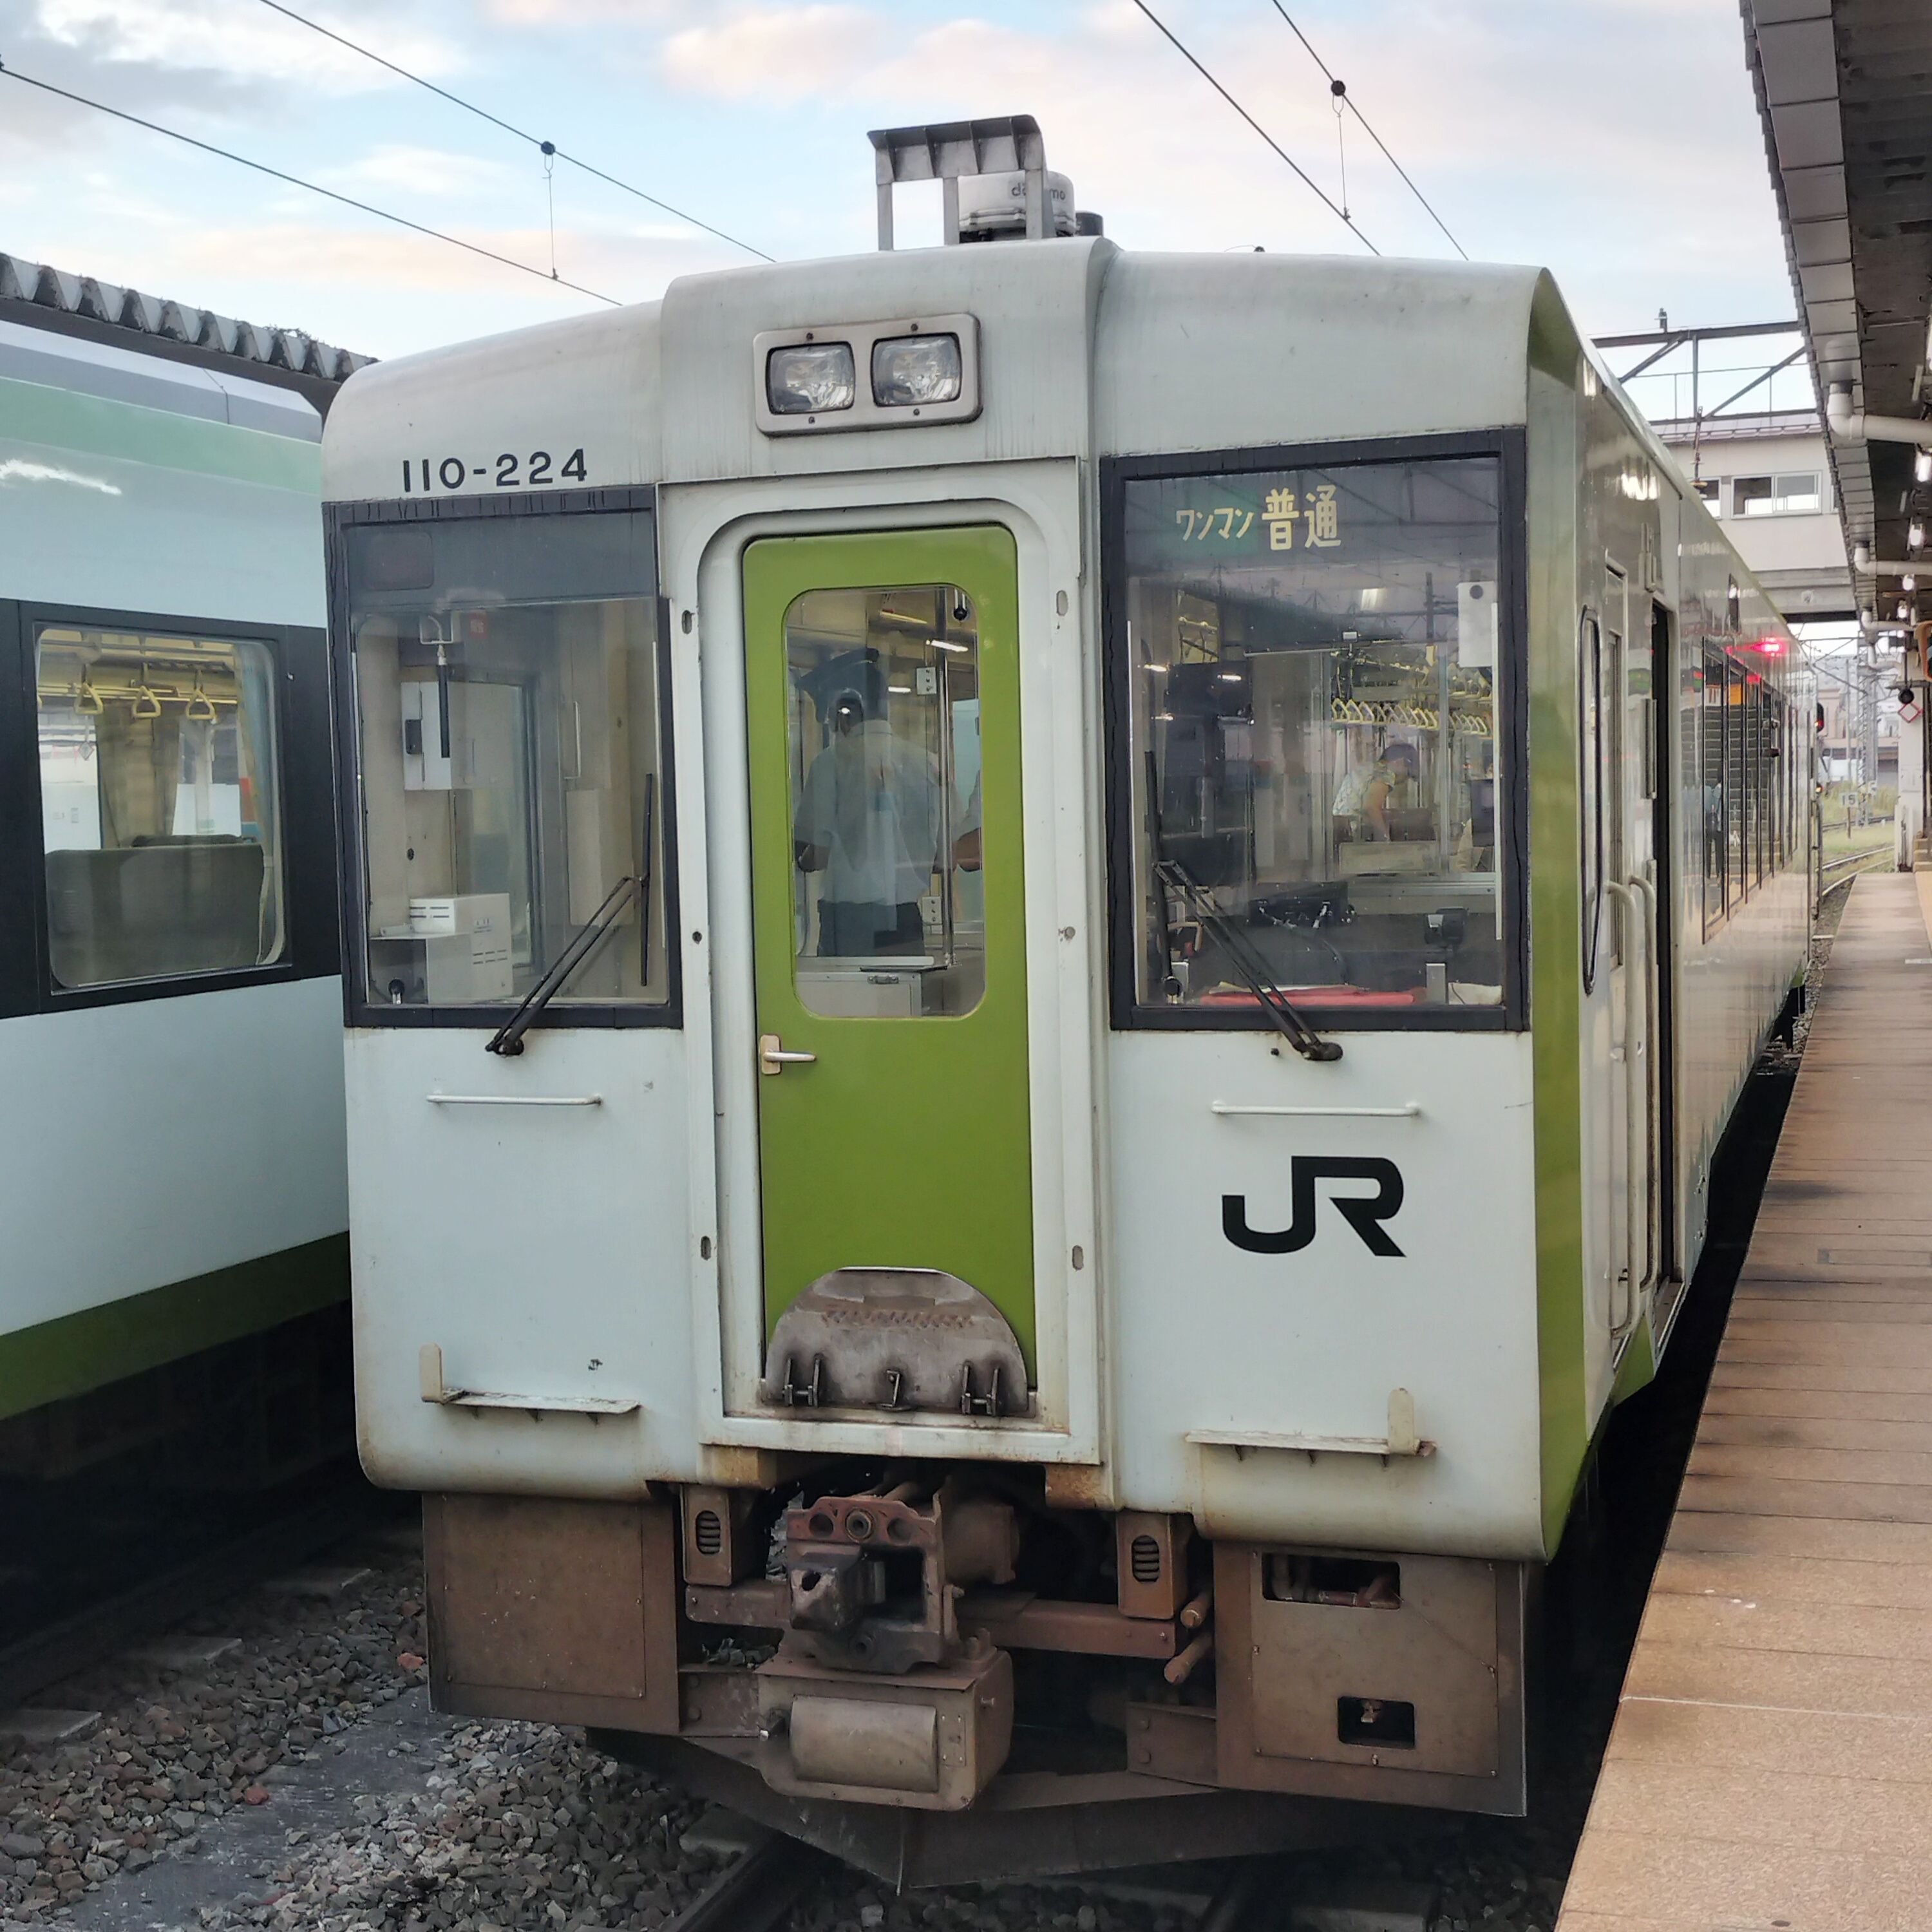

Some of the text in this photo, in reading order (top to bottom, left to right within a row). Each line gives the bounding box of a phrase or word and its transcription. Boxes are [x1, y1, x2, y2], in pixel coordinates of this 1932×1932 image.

[1011, 182, 1066, 200] dmo
[403, 448, 587, 493] 110-224
[1176, 484, 1341, 551] ワンマン 普通
[1842, 794, 1855, 806] 15
[1222, 1155, 1406, 1258] JR
